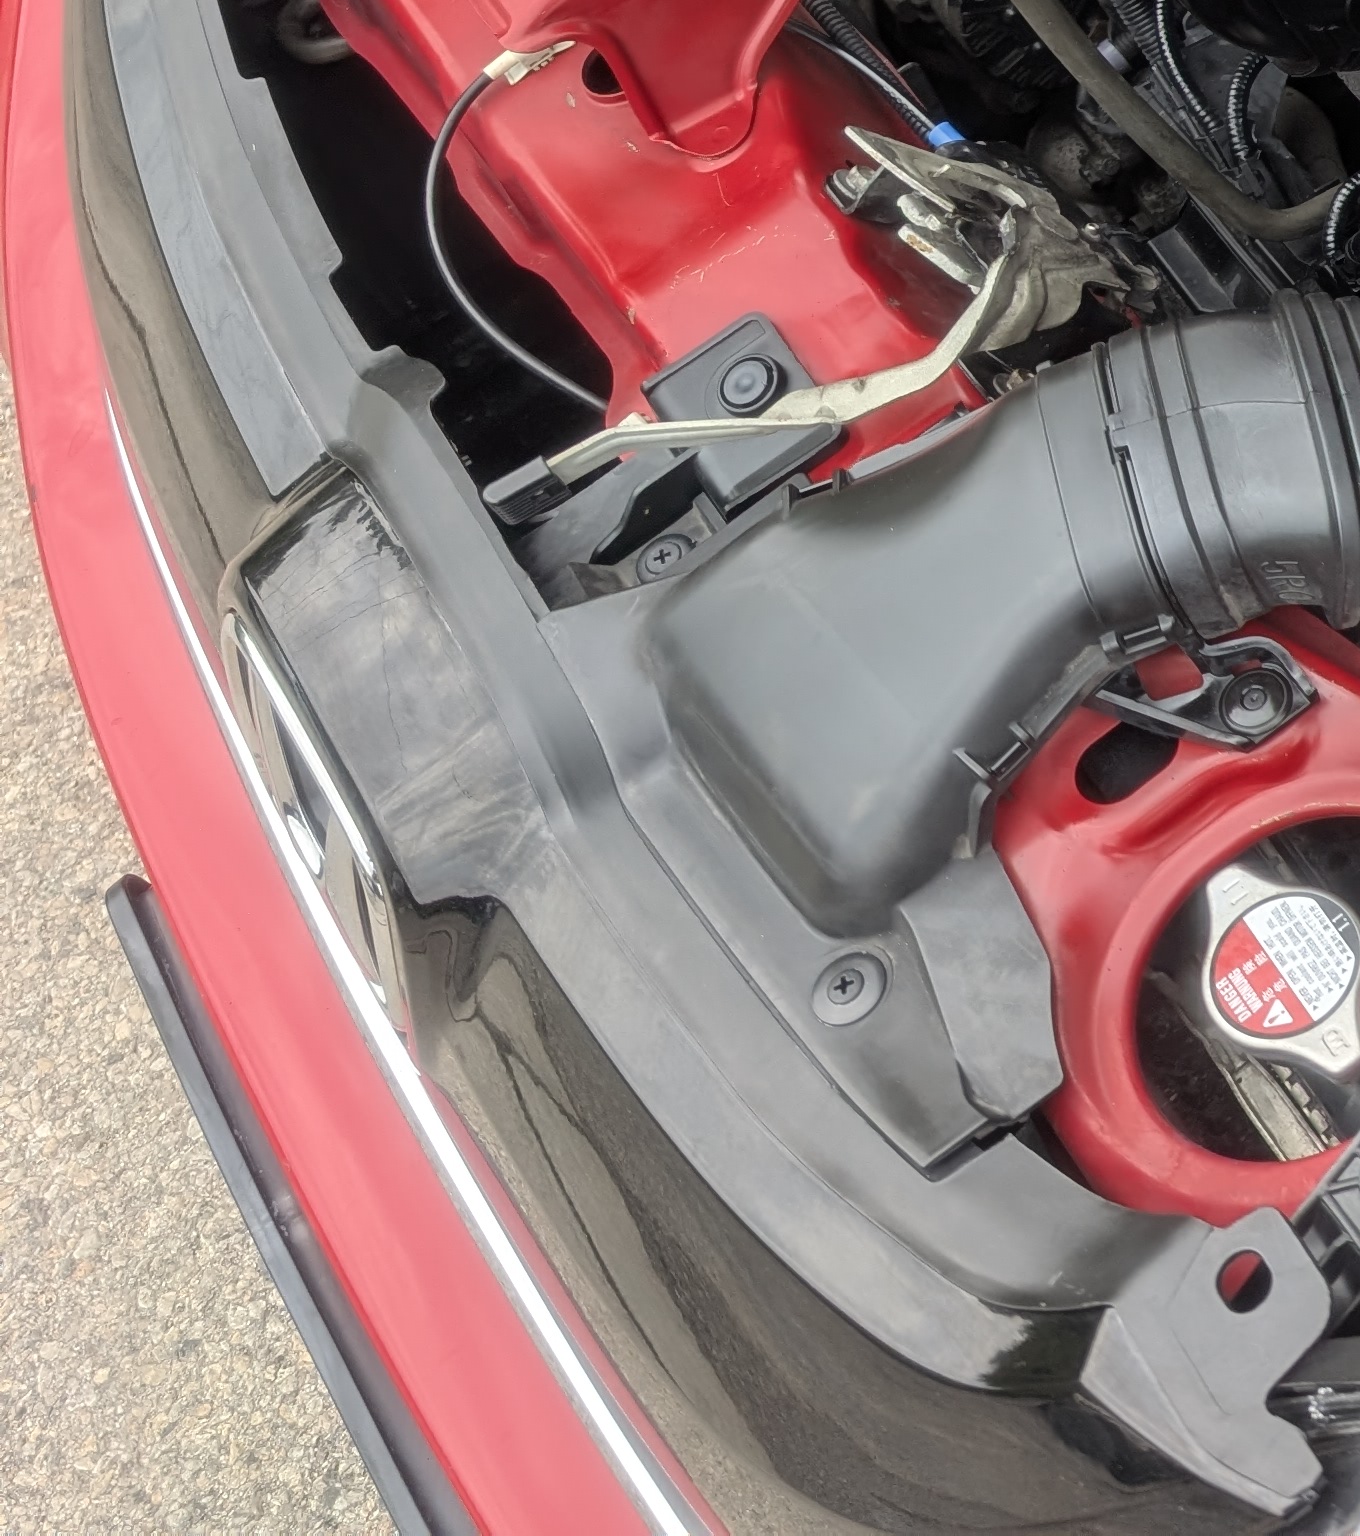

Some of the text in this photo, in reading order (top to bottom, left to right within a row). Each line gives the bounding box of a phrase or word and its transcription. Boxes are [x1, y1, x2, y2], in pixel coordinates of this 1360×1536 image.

[1331, 911, 1351, 932] 1.1
[1213, 975, 1252, 1023] DANGER
[1226, 966, 1265, 1013] WARNUNG
